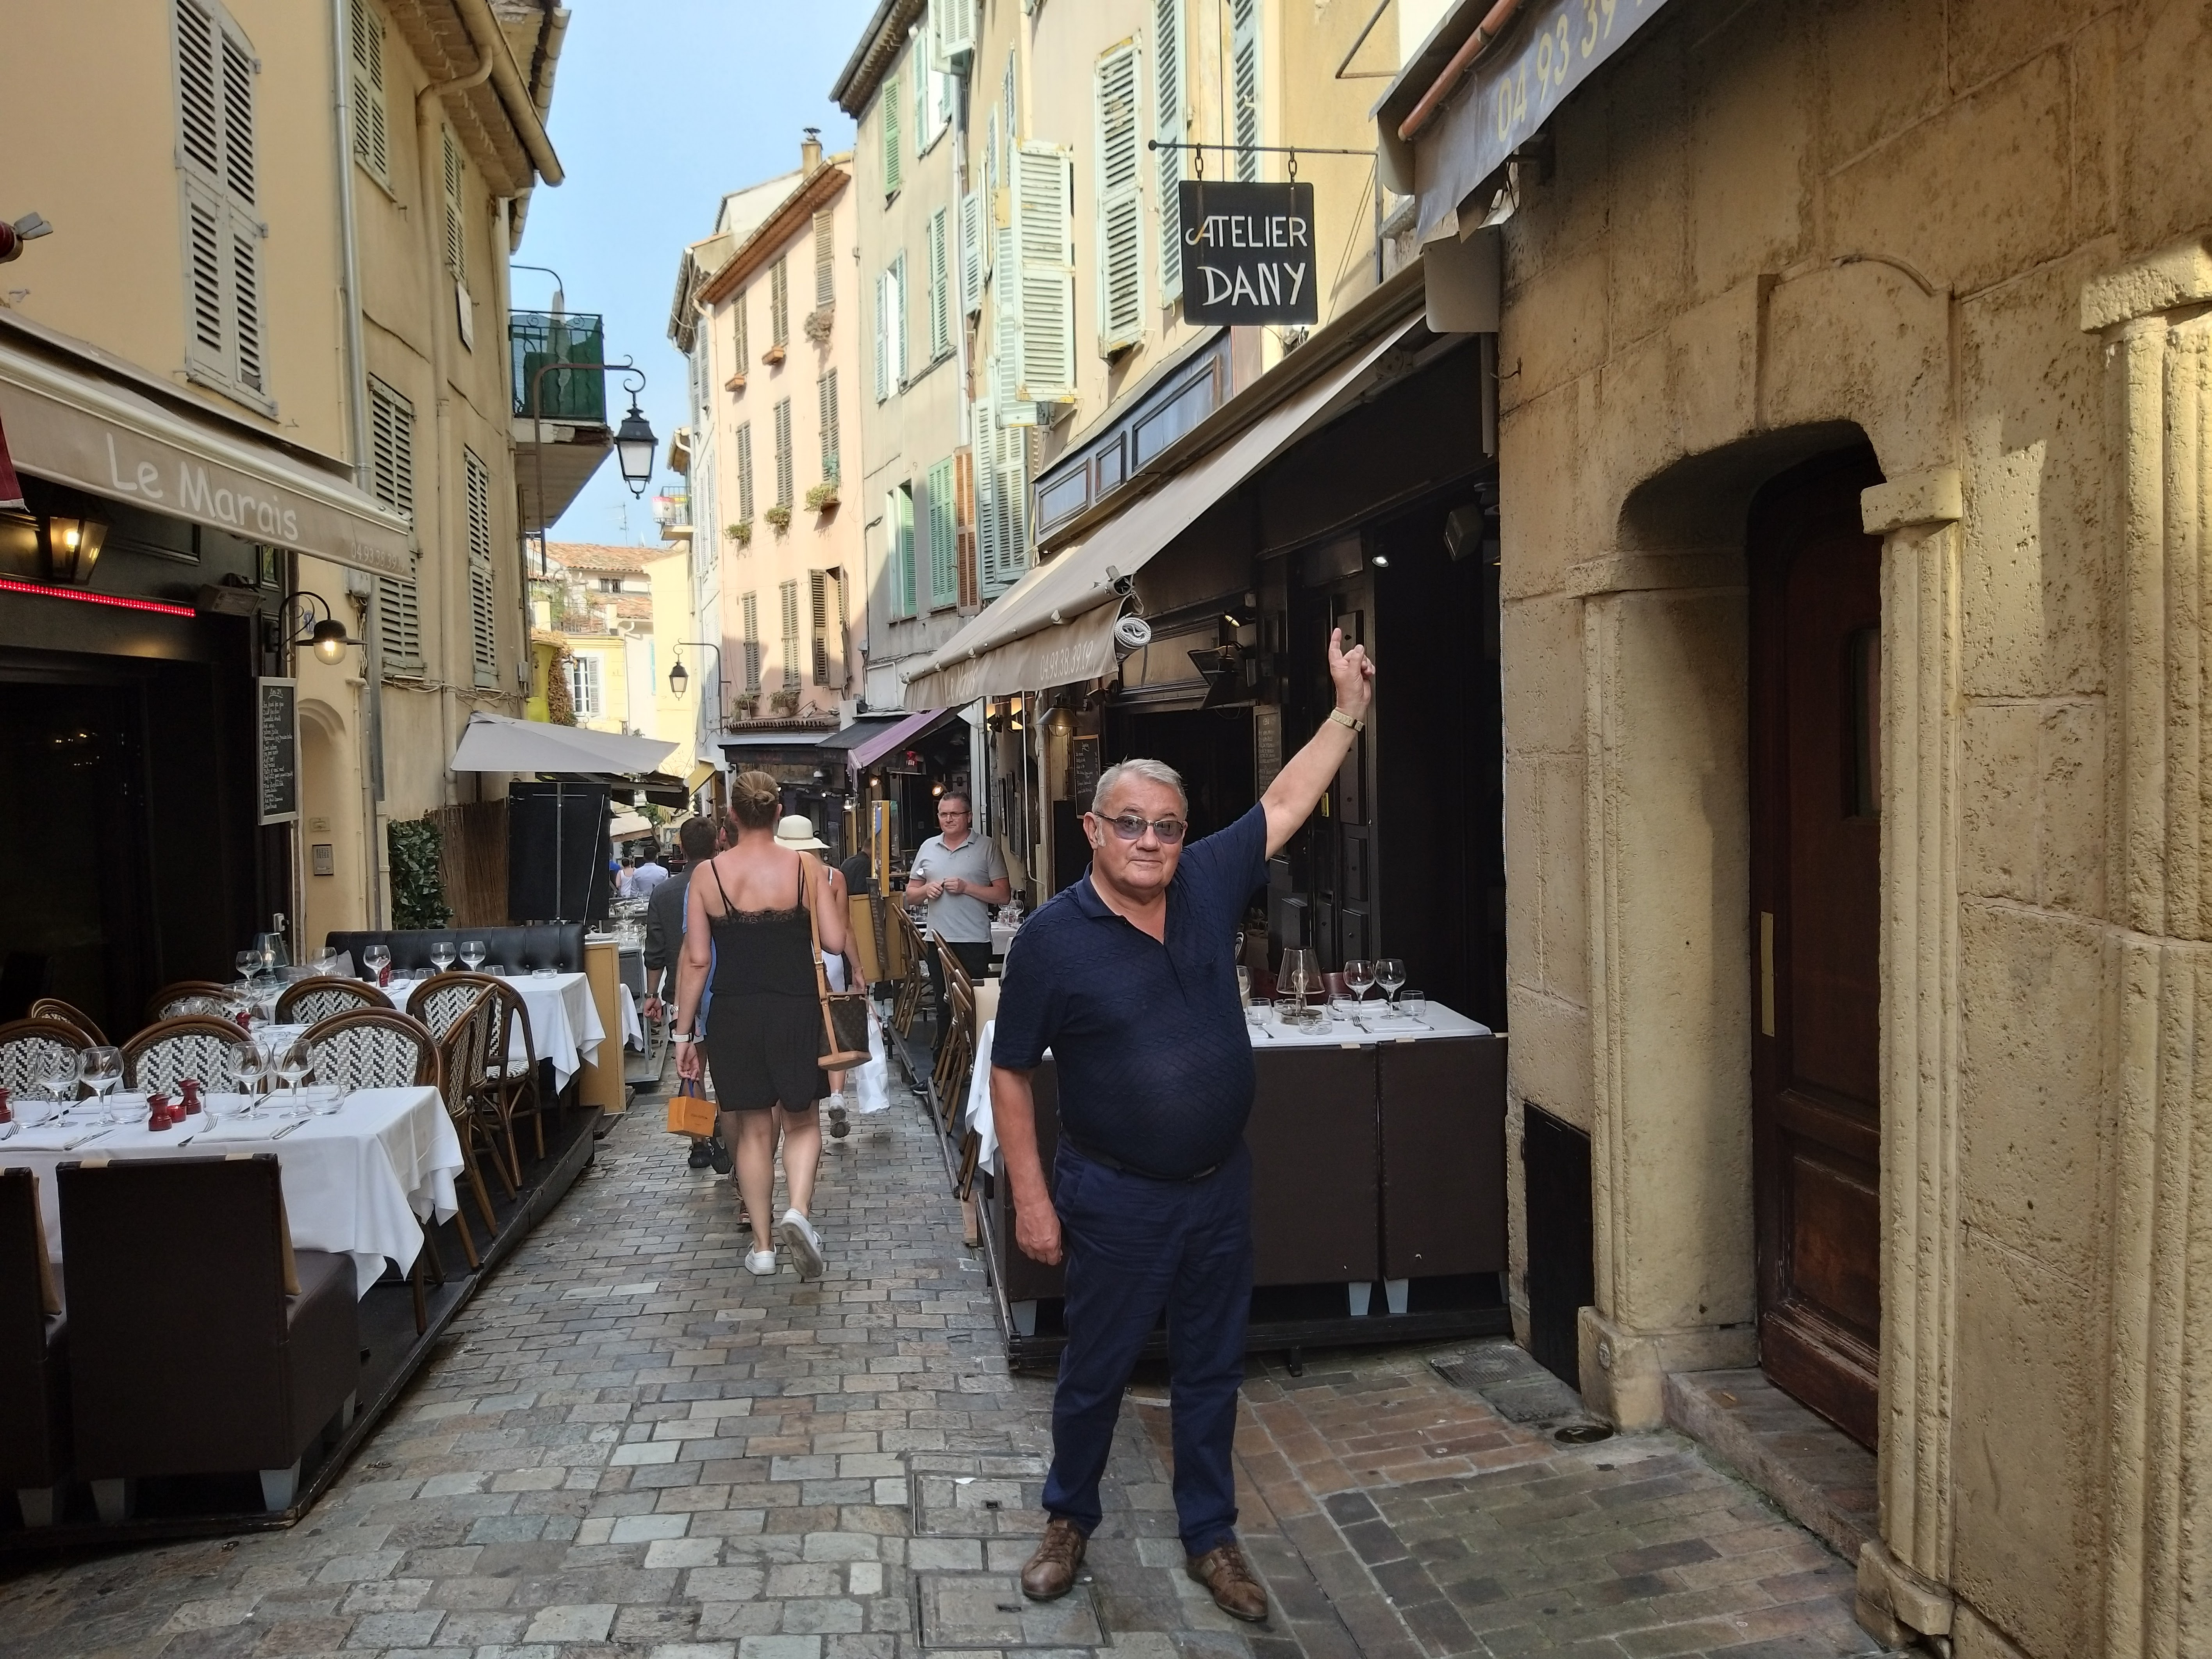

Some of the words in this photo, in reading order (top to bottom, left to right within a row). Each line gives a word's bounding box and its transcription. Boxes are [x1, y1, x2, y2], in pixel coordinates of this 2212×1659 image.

[1497, 60, 1527, 142] 04
[1537, 14, 1570, 106] 93
[1185, 216, 1308, 248] ATELIER
[1197, 262, 1306, 306] DANY
[106, 432, 163, 498] Le
[180, 461, 299, 541] Marais
[1040, 640, 1094, 681] 04.93.38.39.19
